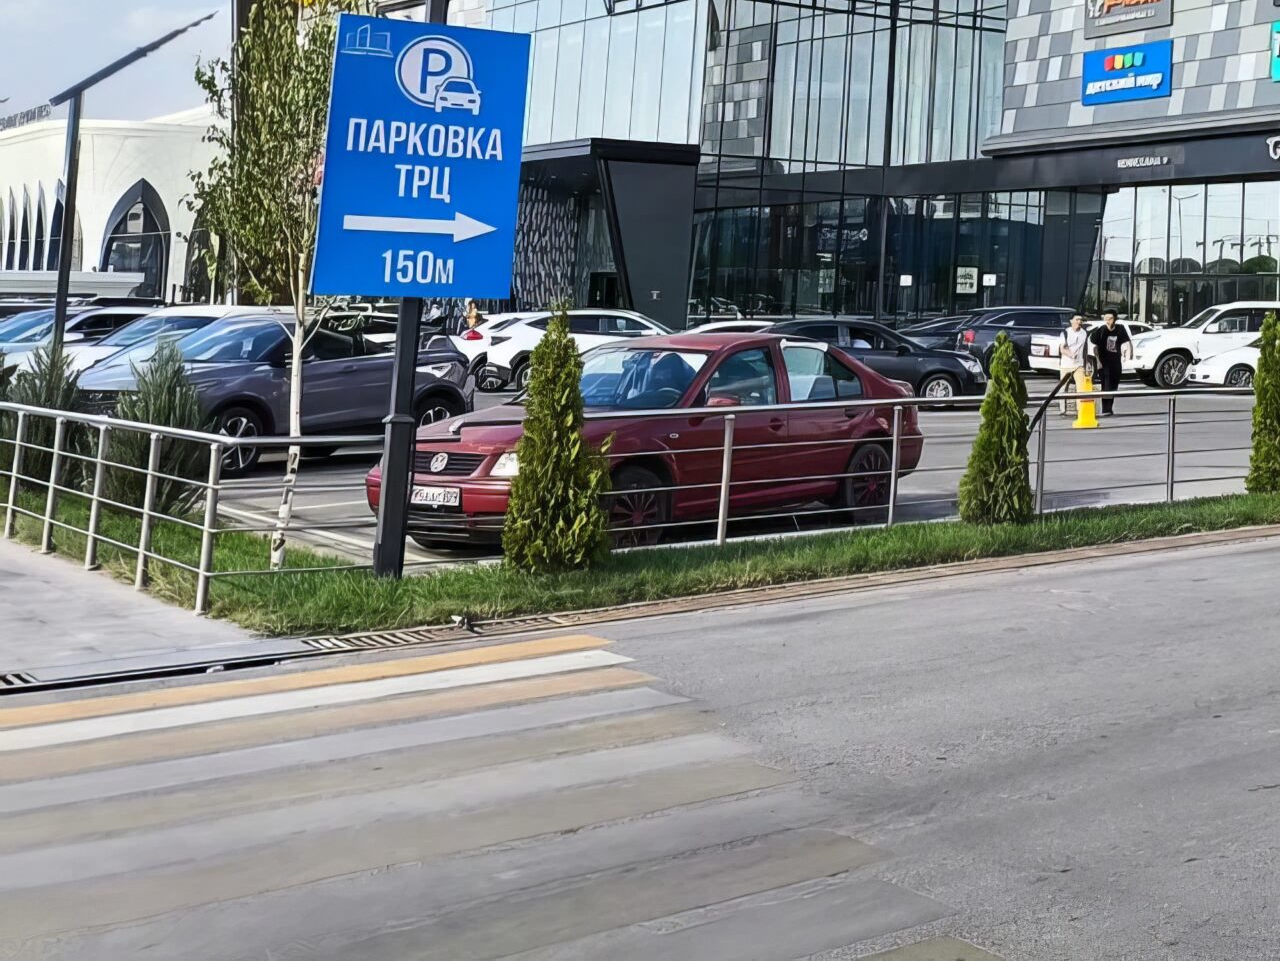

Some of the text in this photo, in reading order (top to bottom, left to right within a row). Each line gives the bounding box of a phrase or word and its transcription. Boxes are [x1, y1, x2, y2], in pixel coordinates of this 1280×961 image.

[419, 47, 453, 94] P
[346, 117, 503, 161] ПАРКОВКА
[394, 164, 451, 204] ТРЦ
